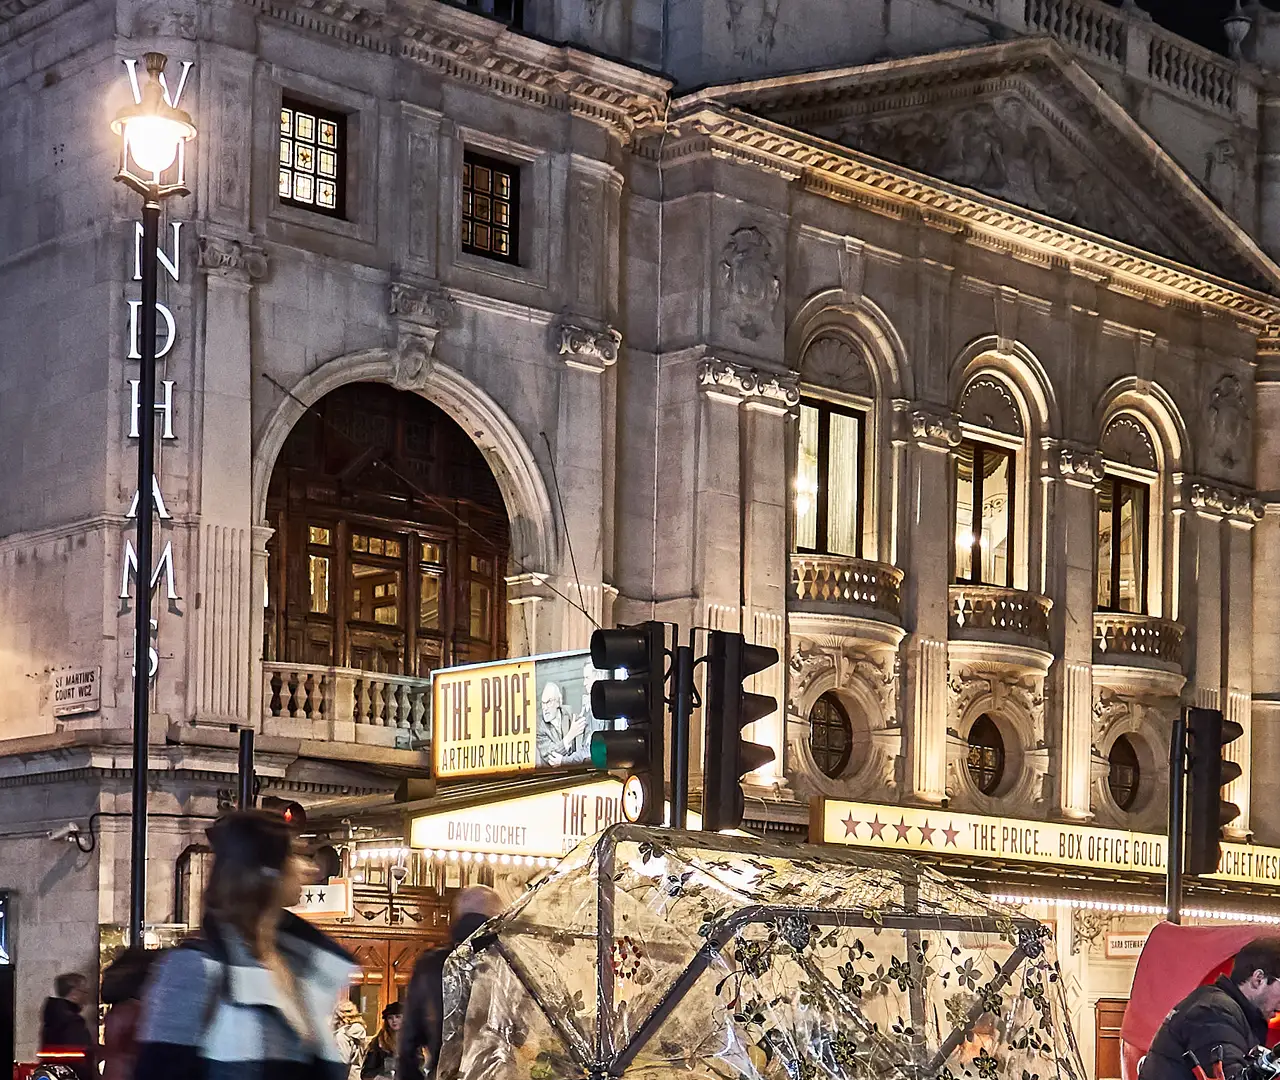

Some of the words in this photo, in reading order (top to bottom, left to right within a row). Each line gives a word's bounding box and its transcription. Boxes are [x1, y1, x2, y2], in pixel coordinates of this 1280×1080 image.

[55, 687, 75, 701] COURT
[78, 684, 92, 698] WC2
[441, 679, 472, 742] THE
[481, 672, 531, 739] PRICE
[441, 744, 485, 771] ARTHUR
[489, 740, 531, 767] MILLER
[561, 792, 588, 837] THE
[595, 795, 623, 835] PRI
[448, 820, 481, 842] DAVID
[485, 823, 527, 846] SUCHET
[1059, 832, 1083, 861] BOX
[1088, 836, 1129, 865] OFFICE
[1133, 840, 1166, 868] GOLD.
